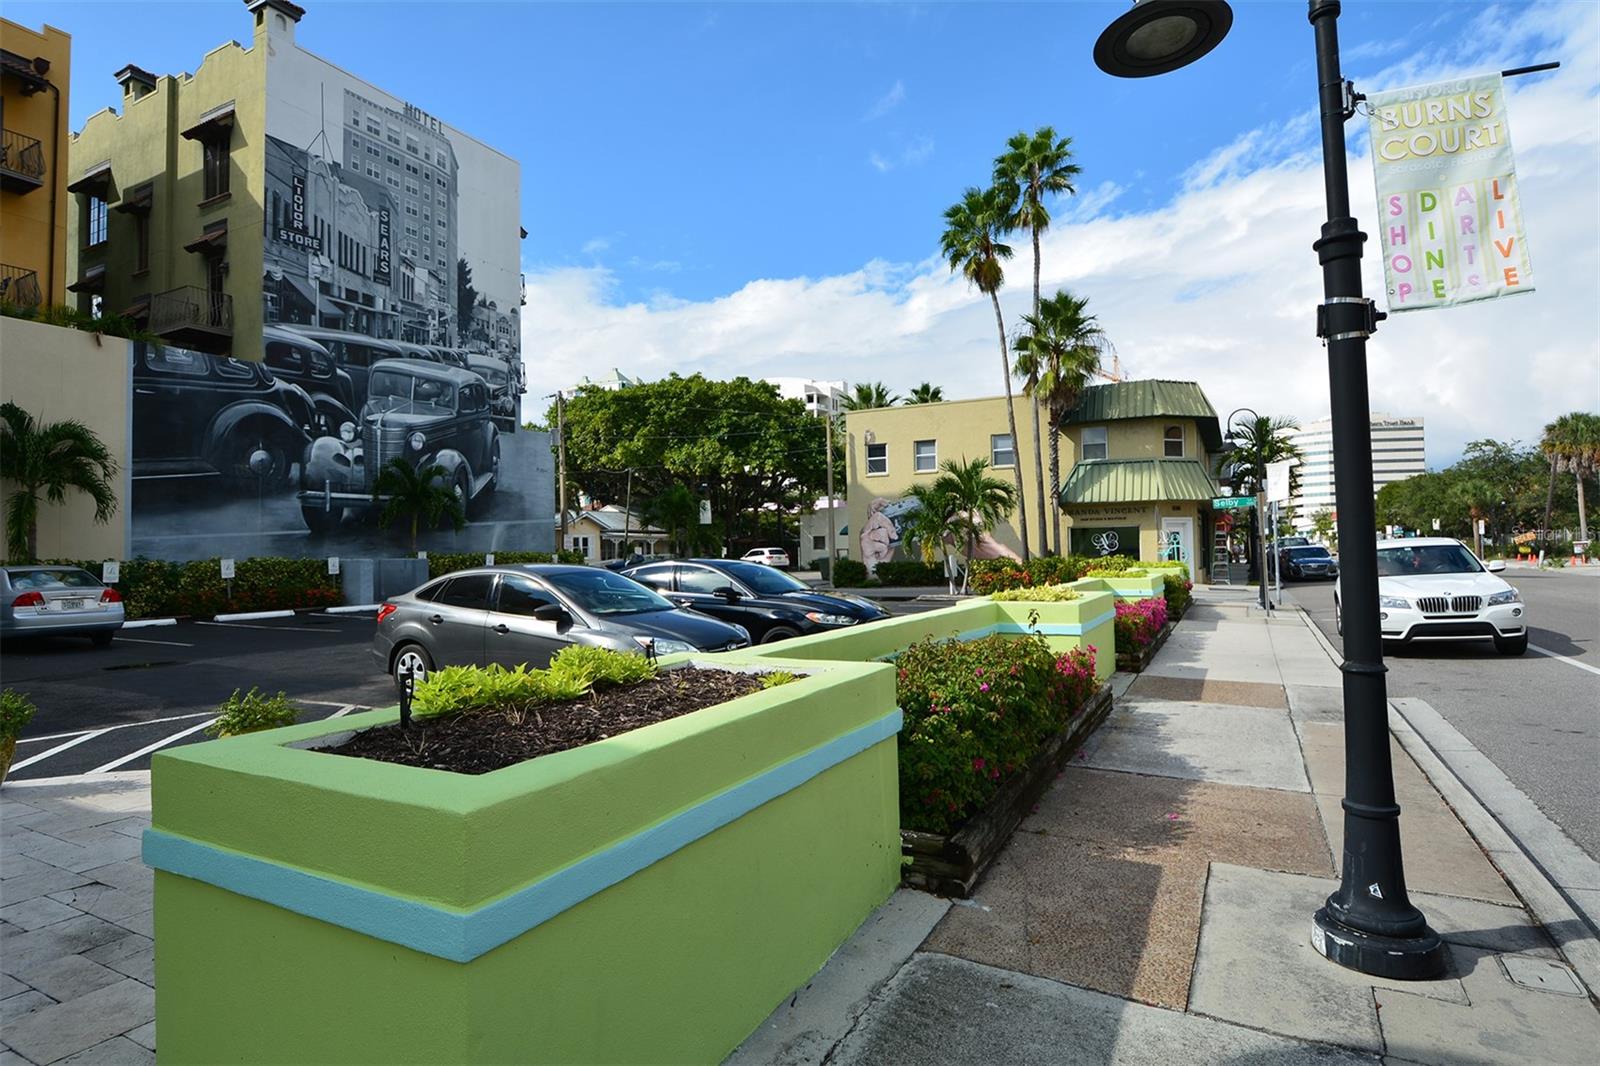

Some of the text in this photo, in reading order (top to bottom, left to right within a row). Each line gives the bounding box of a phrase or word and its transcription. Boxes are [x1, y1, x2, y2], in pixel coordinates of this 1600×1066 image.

[403, 101, 445, 137] HOTEL
[1381, 94, 1493, 132] BURNS
[1380, 122, 1501, 162] COURT
[293, 177, 304, 230] LIQUOR
[279, 229, 321, 250] STORE
[379, 210, 391, 274] SEARS
[1387, 194, 1413, 303] SHOP
[1419, 191, 1446, 299] DINE
[1454, 186, 1481, 291] ARTS
[1492, 179, 1520, 287] LIVE
[1104, 505, 1148, 515] VINCENT
[1214, 499, 1239, 508] Selby
